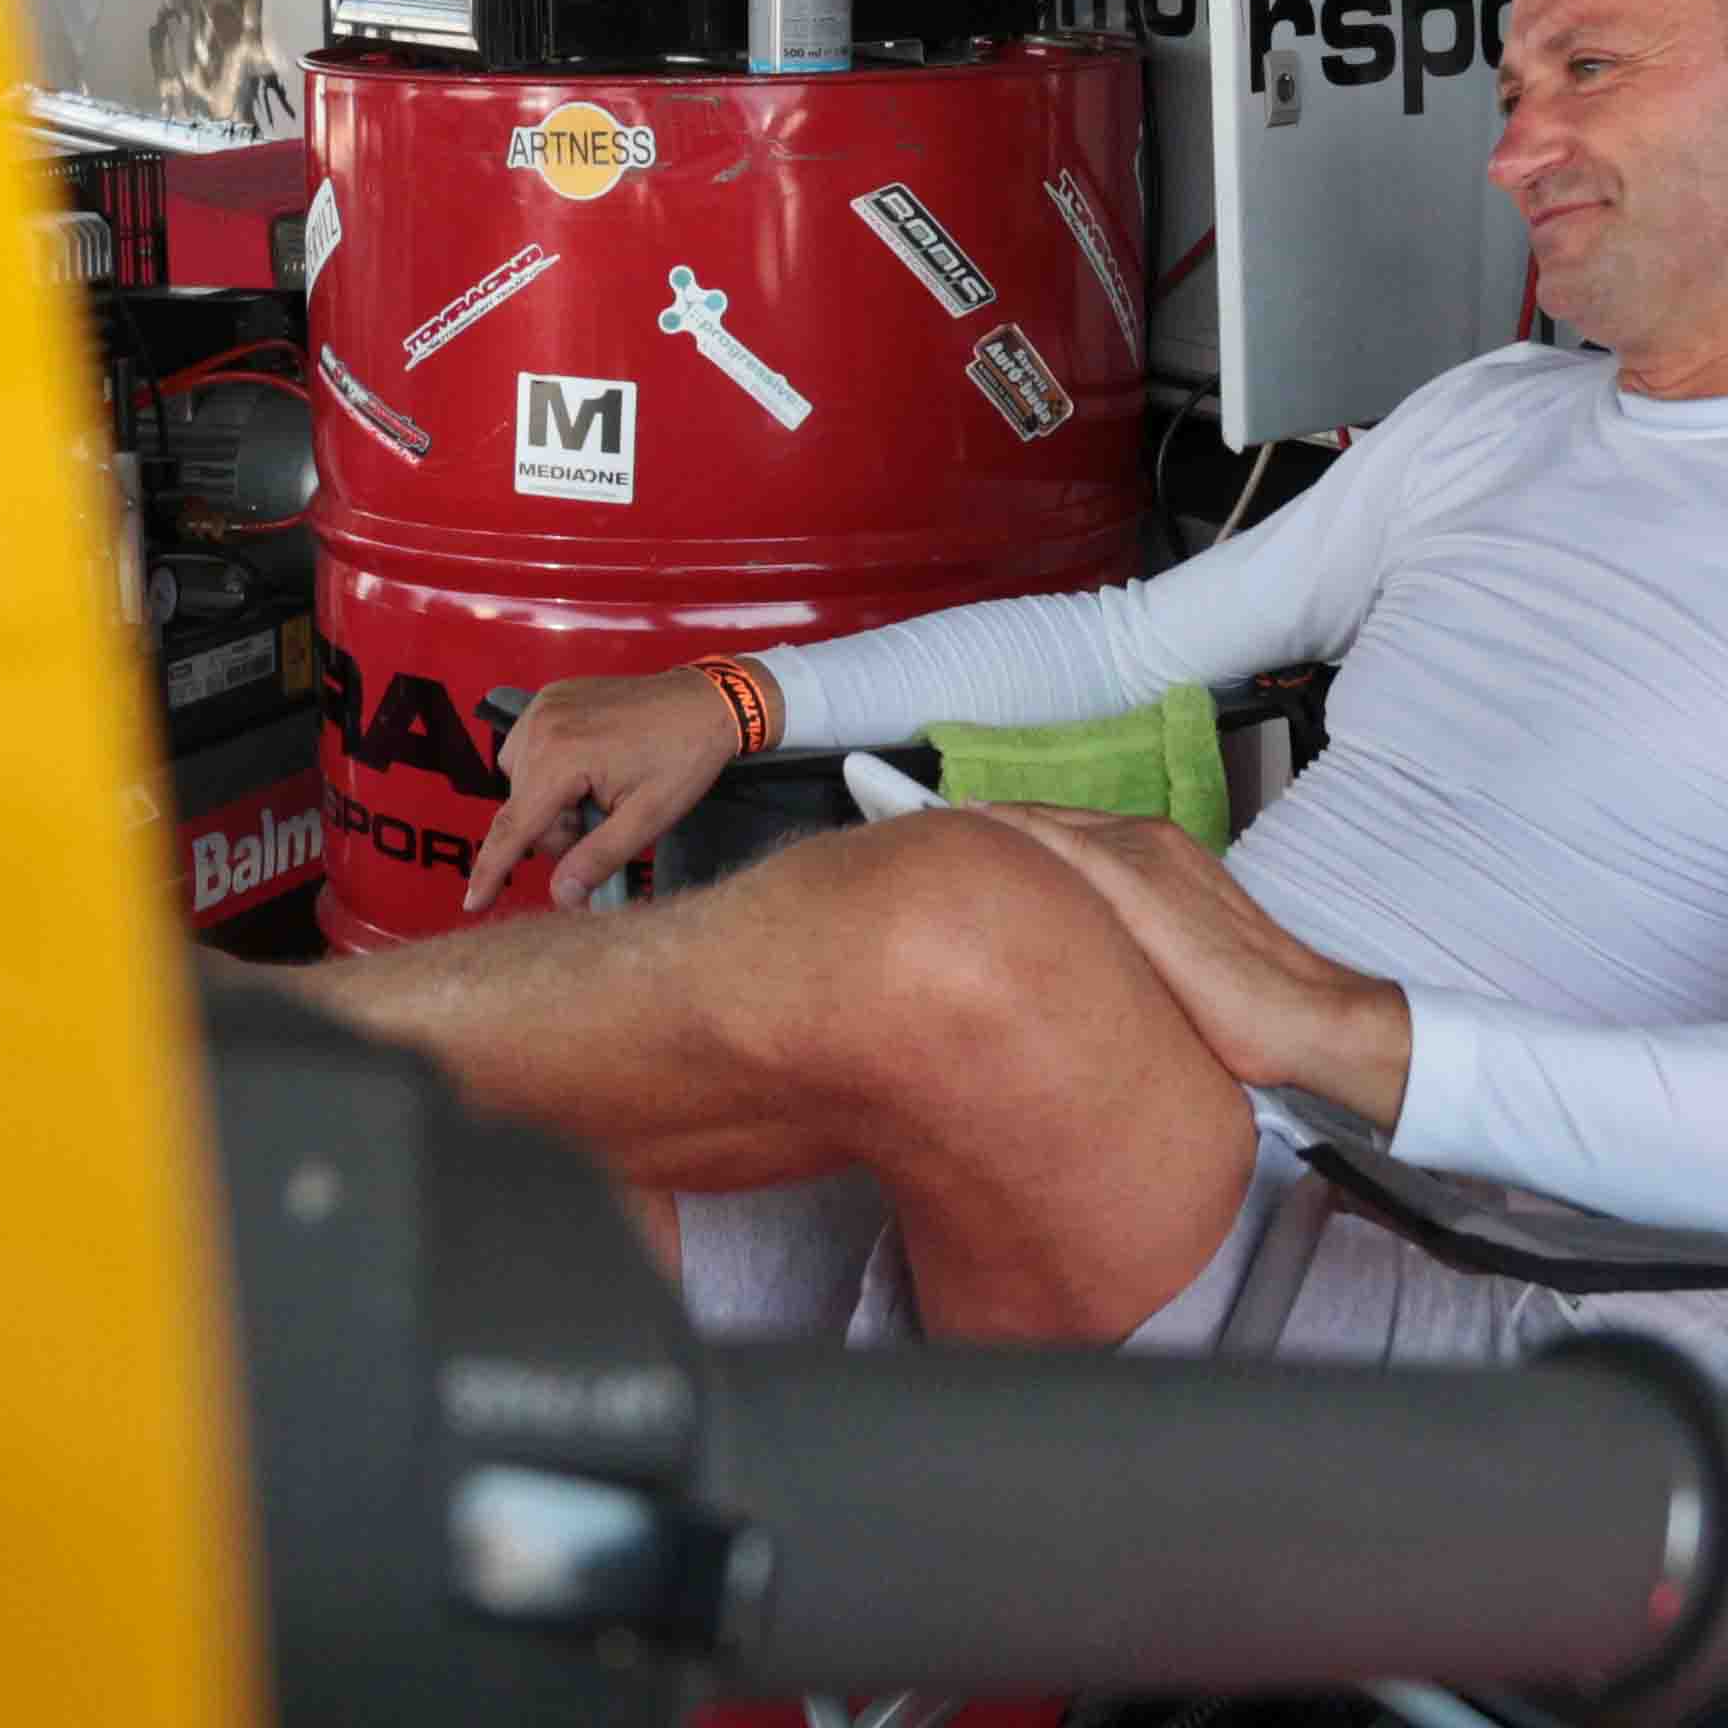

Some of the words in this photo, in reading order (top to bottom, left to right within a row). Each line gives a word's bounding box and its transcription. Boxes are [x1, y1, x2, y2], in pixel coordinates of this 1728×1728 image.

[511, 130, 651, 166] ARTNESS
[407, 244, 542, 352] TOMRACING
[518, 461, 630, 486] MEDIAONE
